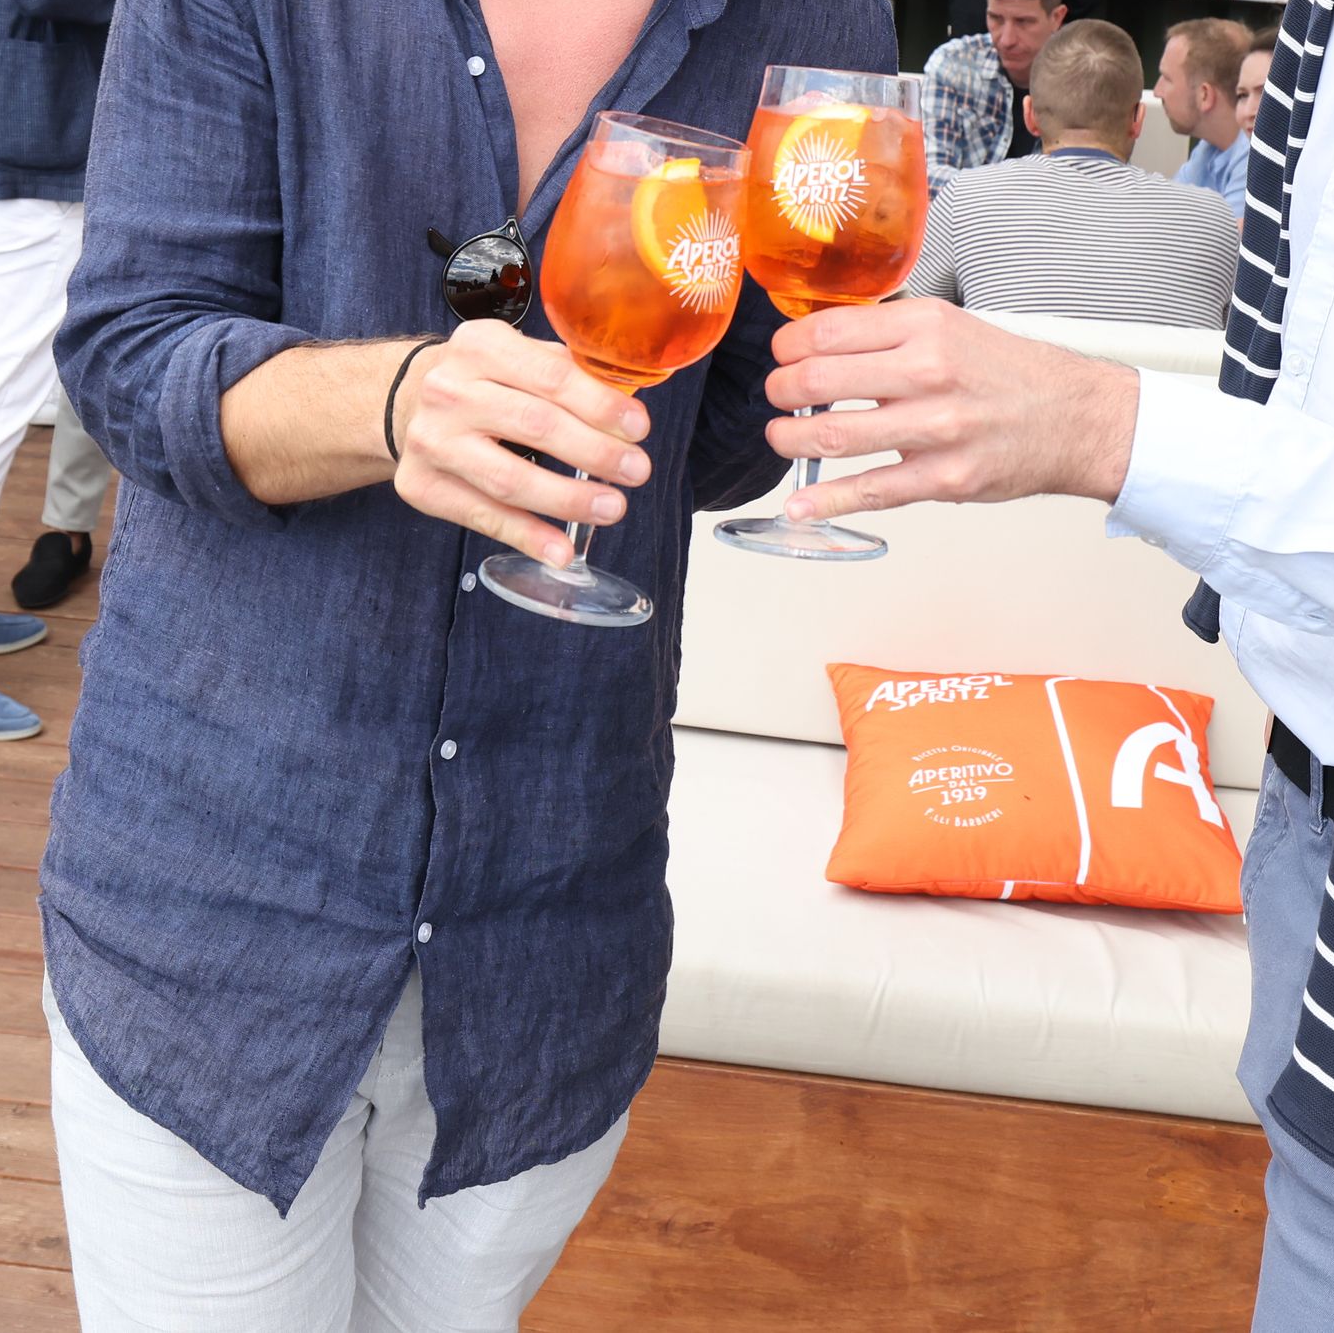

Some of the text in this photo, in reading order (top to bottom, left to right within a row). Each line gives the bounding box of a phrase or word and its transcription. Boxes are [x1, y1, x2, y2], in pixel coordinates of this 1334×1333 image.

[773, 158, 865, 193] APEROL
[785, 182, 850, 206] SPRITZ
[666, 233, 741, 271] APEROL
[678, 259, 732, 285] SPRITZ
[865, 674, 1014, 712] APEROL
[888, 685, 991, 712] SPRITZ
[907, 762, 1014, 788] APERITIVO
[948, 778, 978, 789] DAL
[940, 785, 988, 806] 1919
